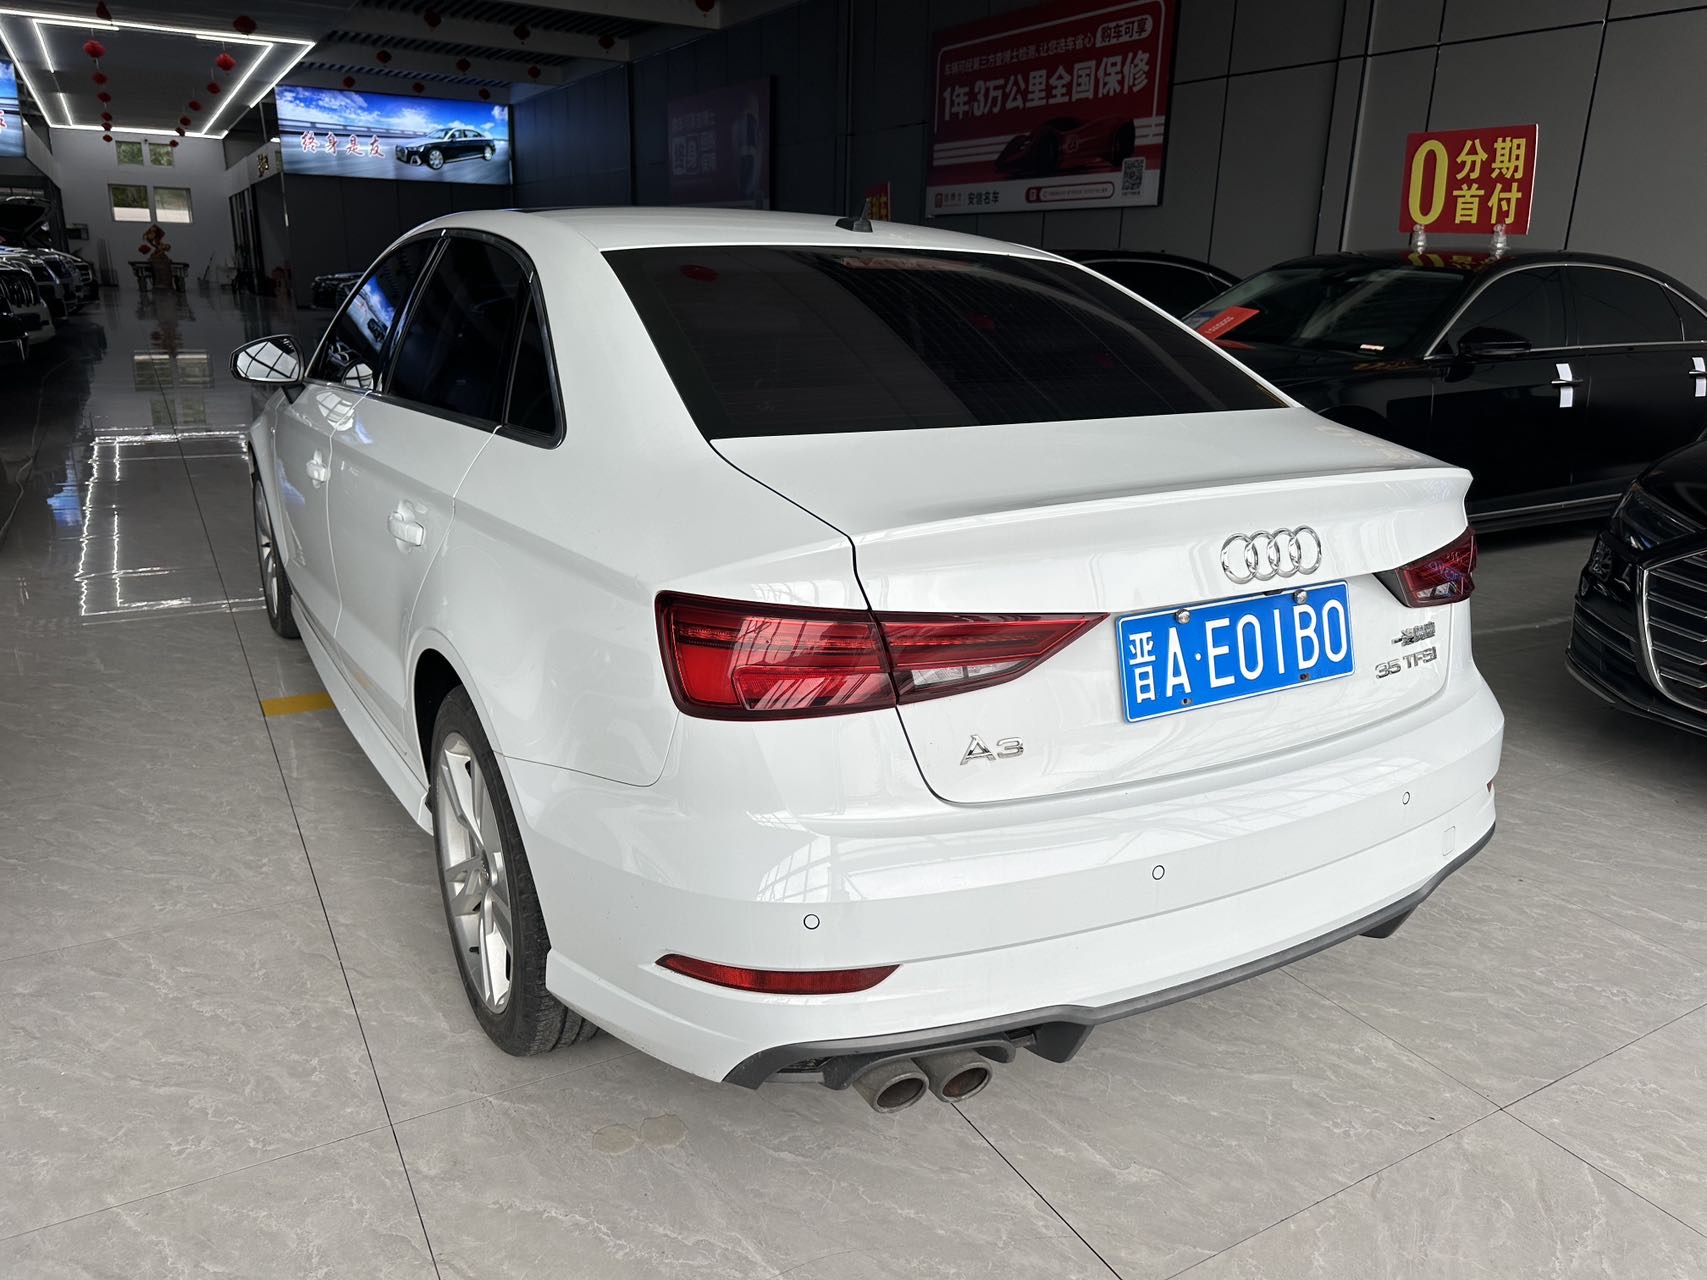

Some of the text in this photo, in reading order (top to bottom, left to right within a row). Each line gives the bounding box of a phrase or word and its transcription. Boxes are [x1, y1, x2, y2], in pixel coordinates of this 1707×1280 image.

[1100, 17, 1149, 43] 购车可享
[300, 130, 386, 158] 终身是友
[1455, 137, 1526, 179] 分期
[1408, 139, 1449, 225] 0
[1453, 182, 1522, 224] 首付
[1375, 658, 1401, 679] 35
[960, 735, 1024, 765] A3
